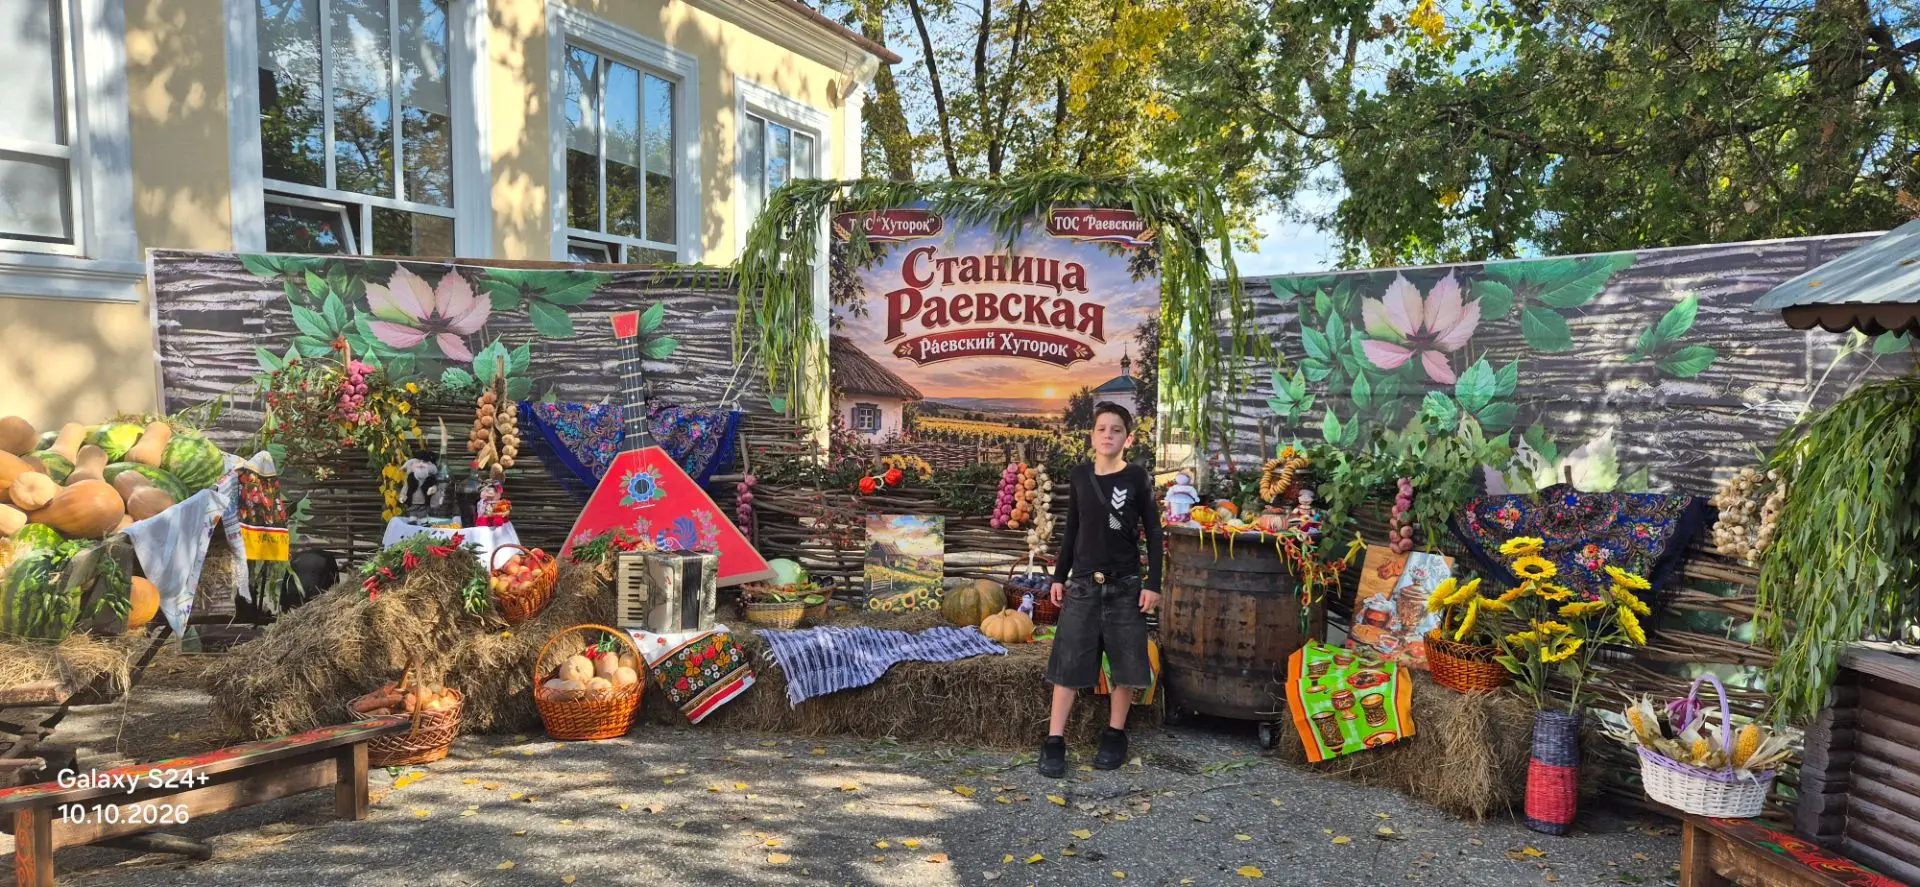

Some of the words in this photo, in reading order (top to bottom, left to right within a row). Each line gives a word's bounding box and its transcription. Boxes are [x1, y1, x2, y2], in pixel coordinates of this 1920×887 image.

[849, 217, 874, 232] ТС
[1054, 216, 1080, 231] ТОС
[901, 246, 1089, 296] Станица
[884, 287, 1106, 344] Раевская
[919, 331, 996, 360] Раевский
[1000, 331, 1069, 358] Хуторок
